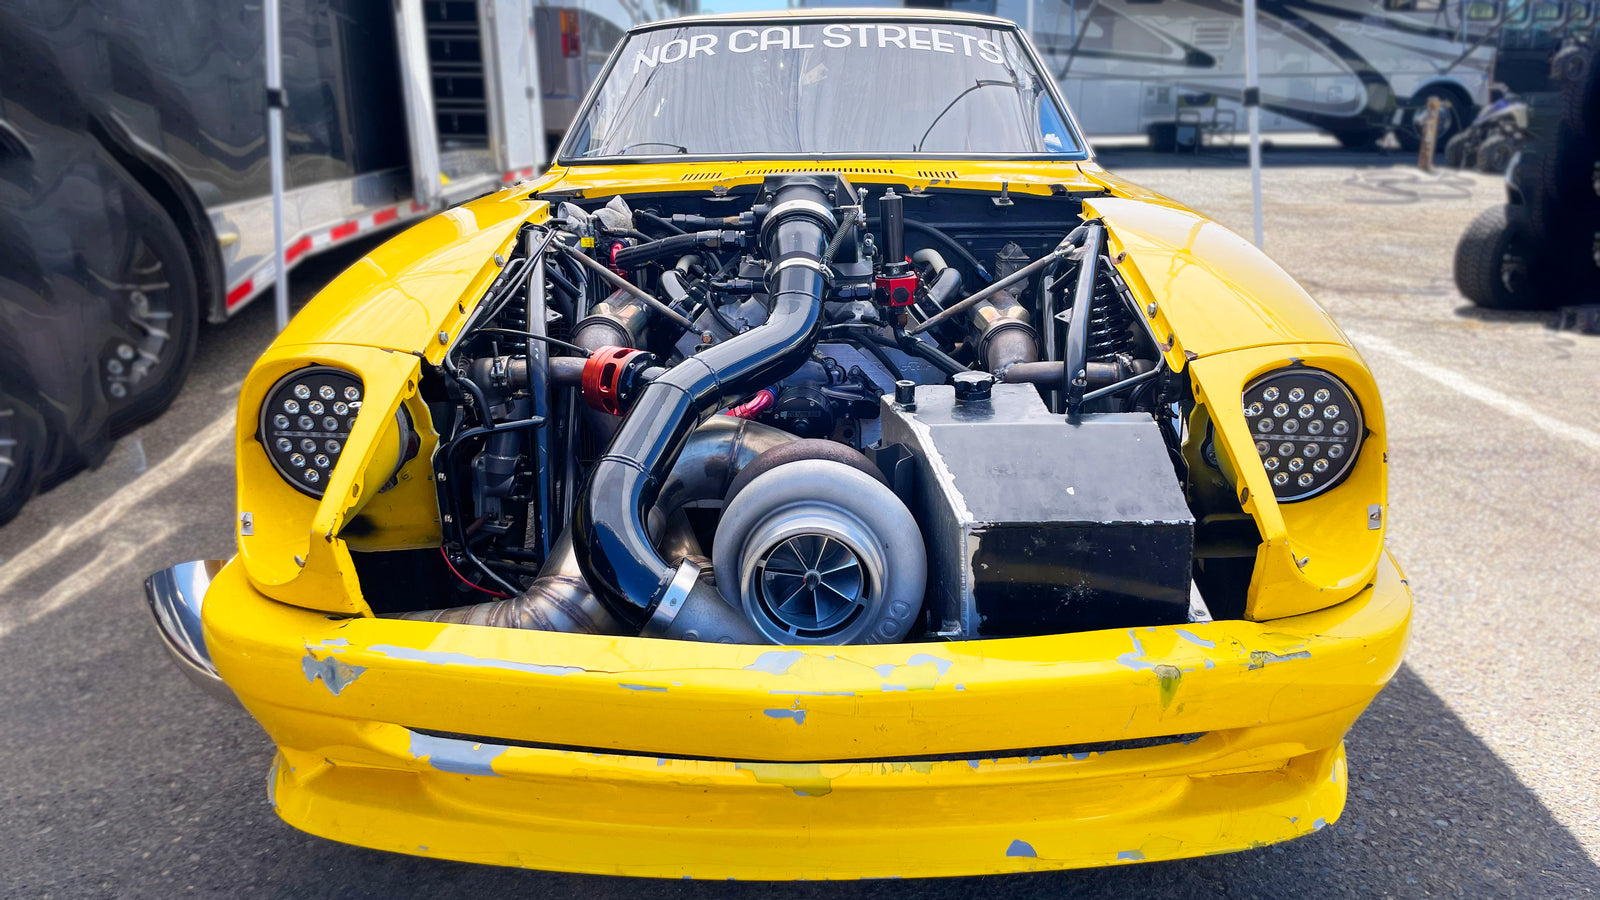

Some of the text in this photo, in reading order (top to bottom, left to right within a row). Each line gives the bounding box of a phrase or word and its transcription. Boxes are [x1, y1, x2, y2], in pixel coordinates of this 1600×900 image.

[633, 24, 1004, 74] NOR CAL STREETS
